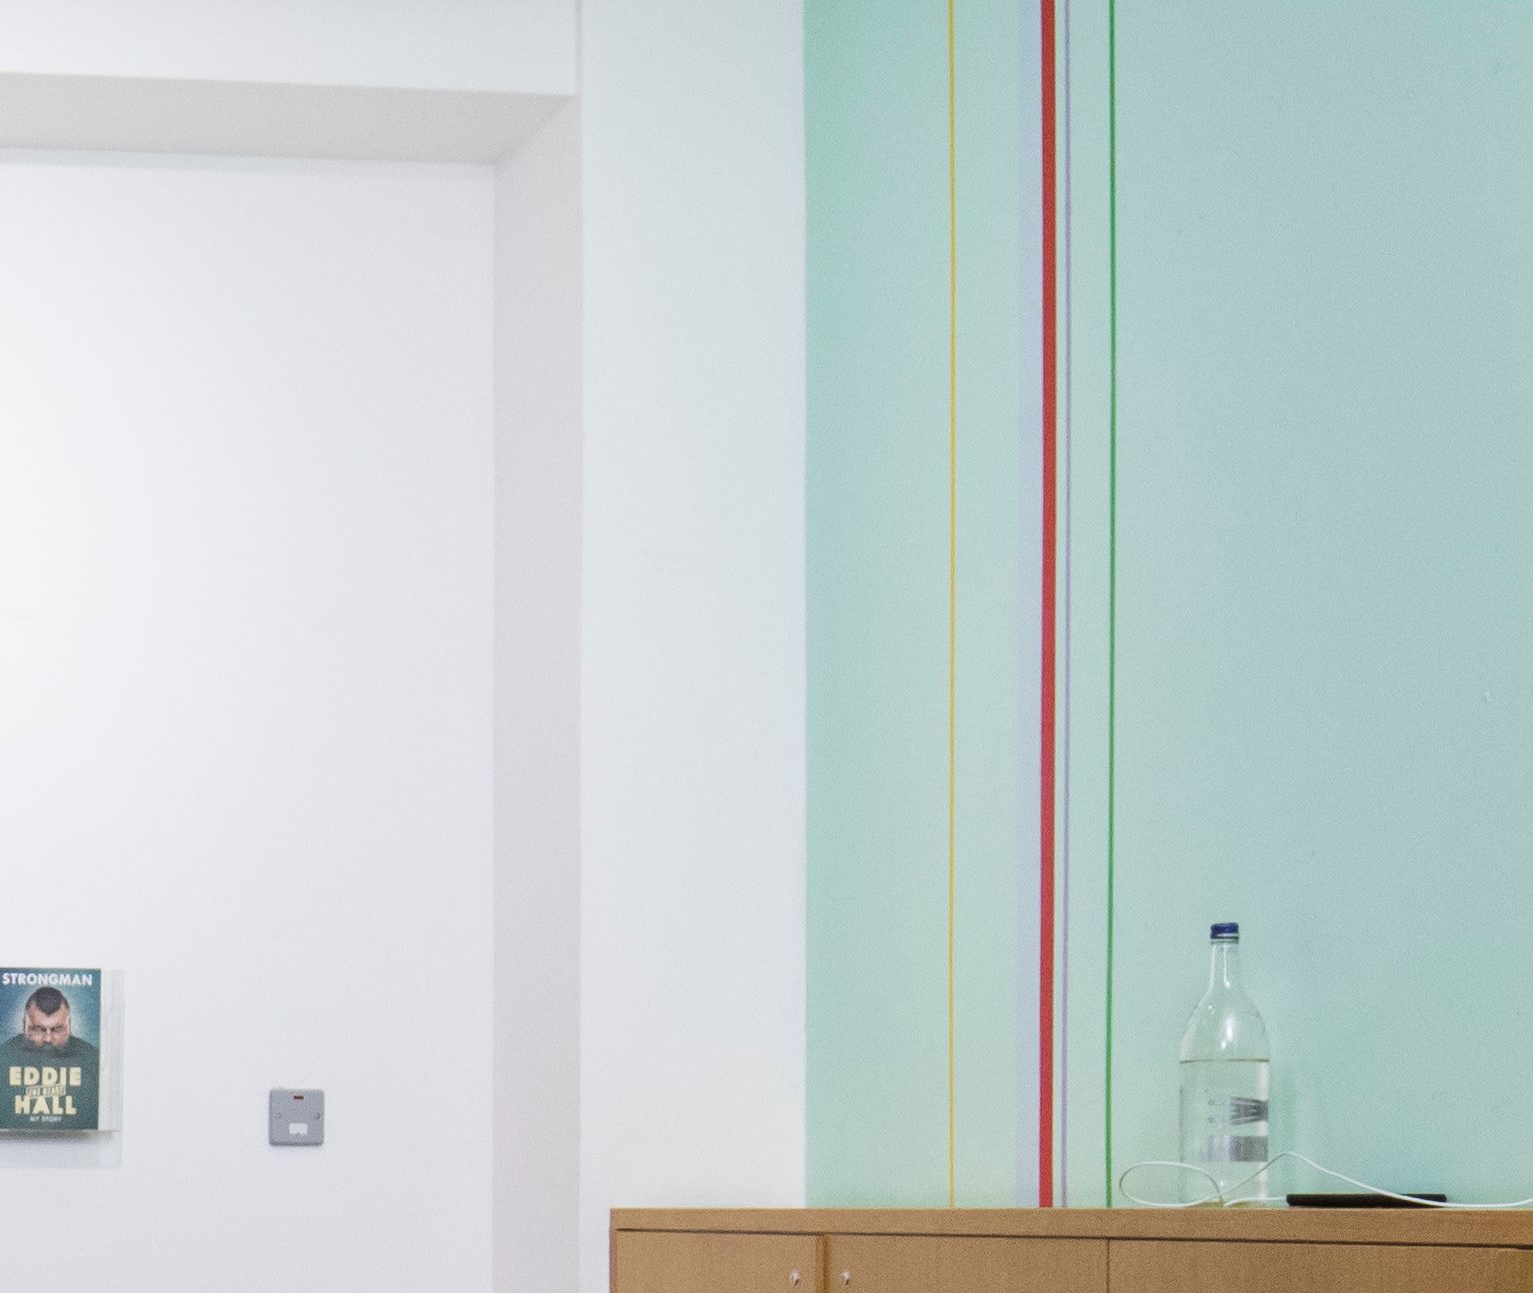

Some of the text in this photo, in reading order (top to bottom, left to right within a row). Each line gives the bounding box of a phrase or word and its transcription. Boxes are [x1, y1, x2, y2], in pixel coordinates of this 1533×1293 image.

[2, 972, 93, 986] STRONGMAN
[9, 1066, 82, 1087] EDDIE
[15, 1095, 77, 1116] HALL
